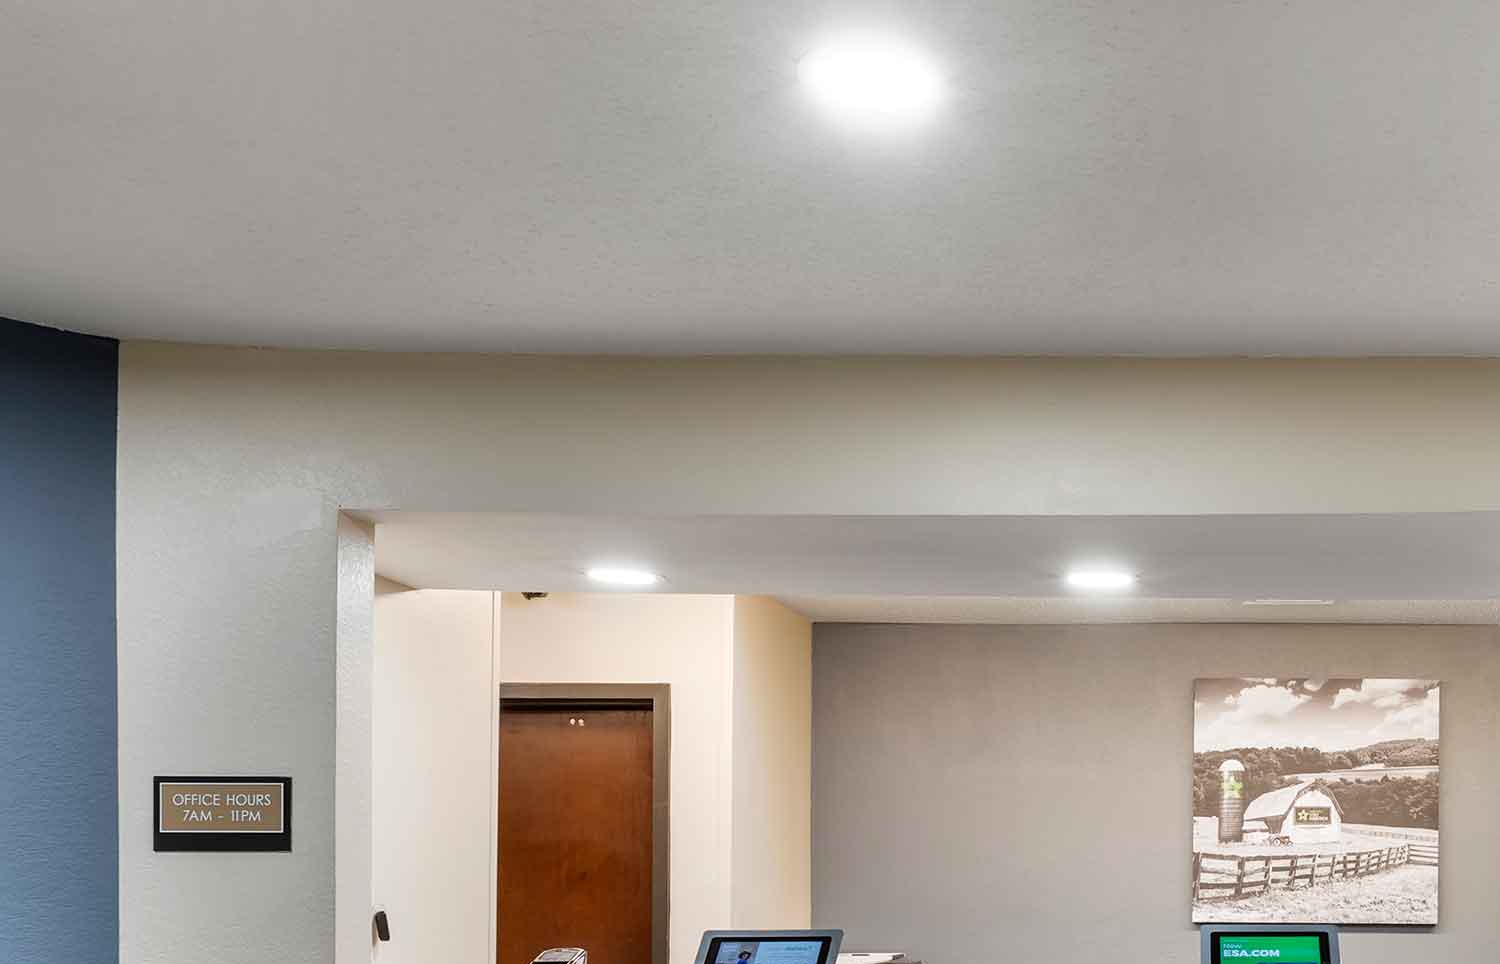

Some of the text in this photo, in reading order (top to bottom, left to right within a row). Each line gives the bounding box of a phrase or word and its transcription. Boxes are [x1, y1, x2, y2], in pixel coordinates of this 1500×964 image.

[172, 794, 272, 806] OFFICE HOURS
[183, 810, 212, 822] 7AM
[231, 810, 262, 822] 11PM
[1223, 949, 1280, 957] ESA.COM
